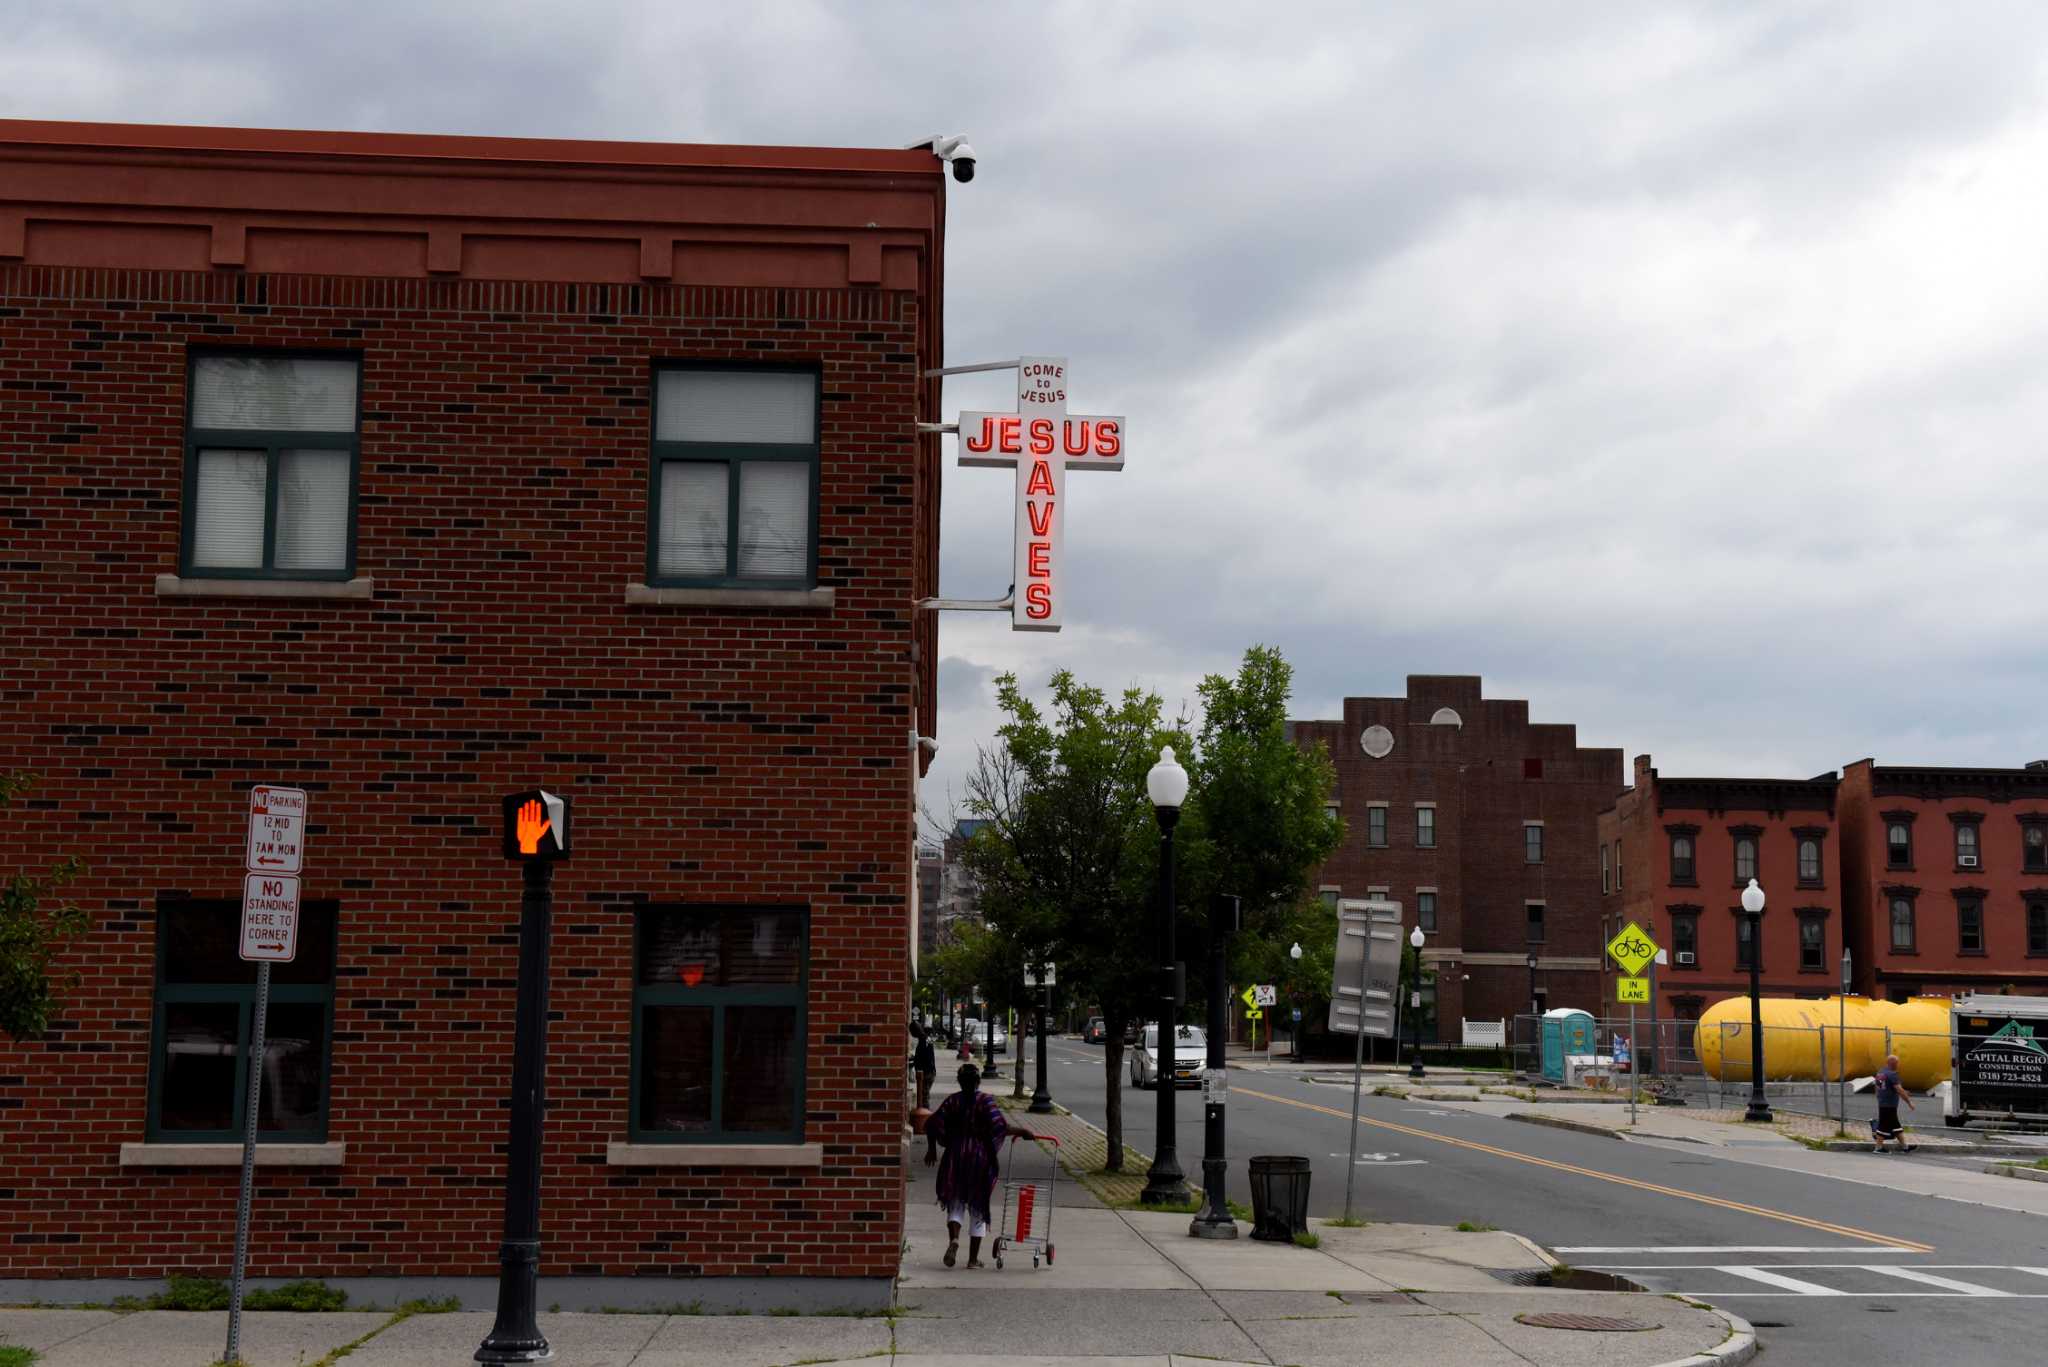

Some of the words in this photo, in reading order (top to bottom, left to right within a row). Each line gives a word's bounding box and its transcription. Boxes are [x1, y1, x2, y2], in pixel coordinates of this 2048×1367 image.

[1023, 364, 1063, 378] COME
[1037, 378, 1050, 388] to
[1021, 390, 1065, 403] JESUS
[967, 417, 1120, 457] JESUS
[255, 792, 267, 808] NO
[270, 795, 302, 809] PARKING
[264, 816, 273, 827] 12
[275, 817, 290, 829] MID
[271, 830, 282, 841] TO
[255, 842, 273, 854] 7AM
[277, 843, 296, 855] MON
[262, 881, 283, 897] NO
[249, 899, 294, 912] STANDING
[248, 913, 274, 925] HERE
[280, 915, 291, 927] TO
[249, 928, 288, 941] CORNER
[1622, 991, 1645, 999] LANE
[1966, 1053, 2011, 1062] CAPITAL
[2013, 1055, 2048, 1064] REGIO
[1979, 1063, 2042, 1071] CONSTRUCTION
[1979, 1072, 2000, 1080] (518)
